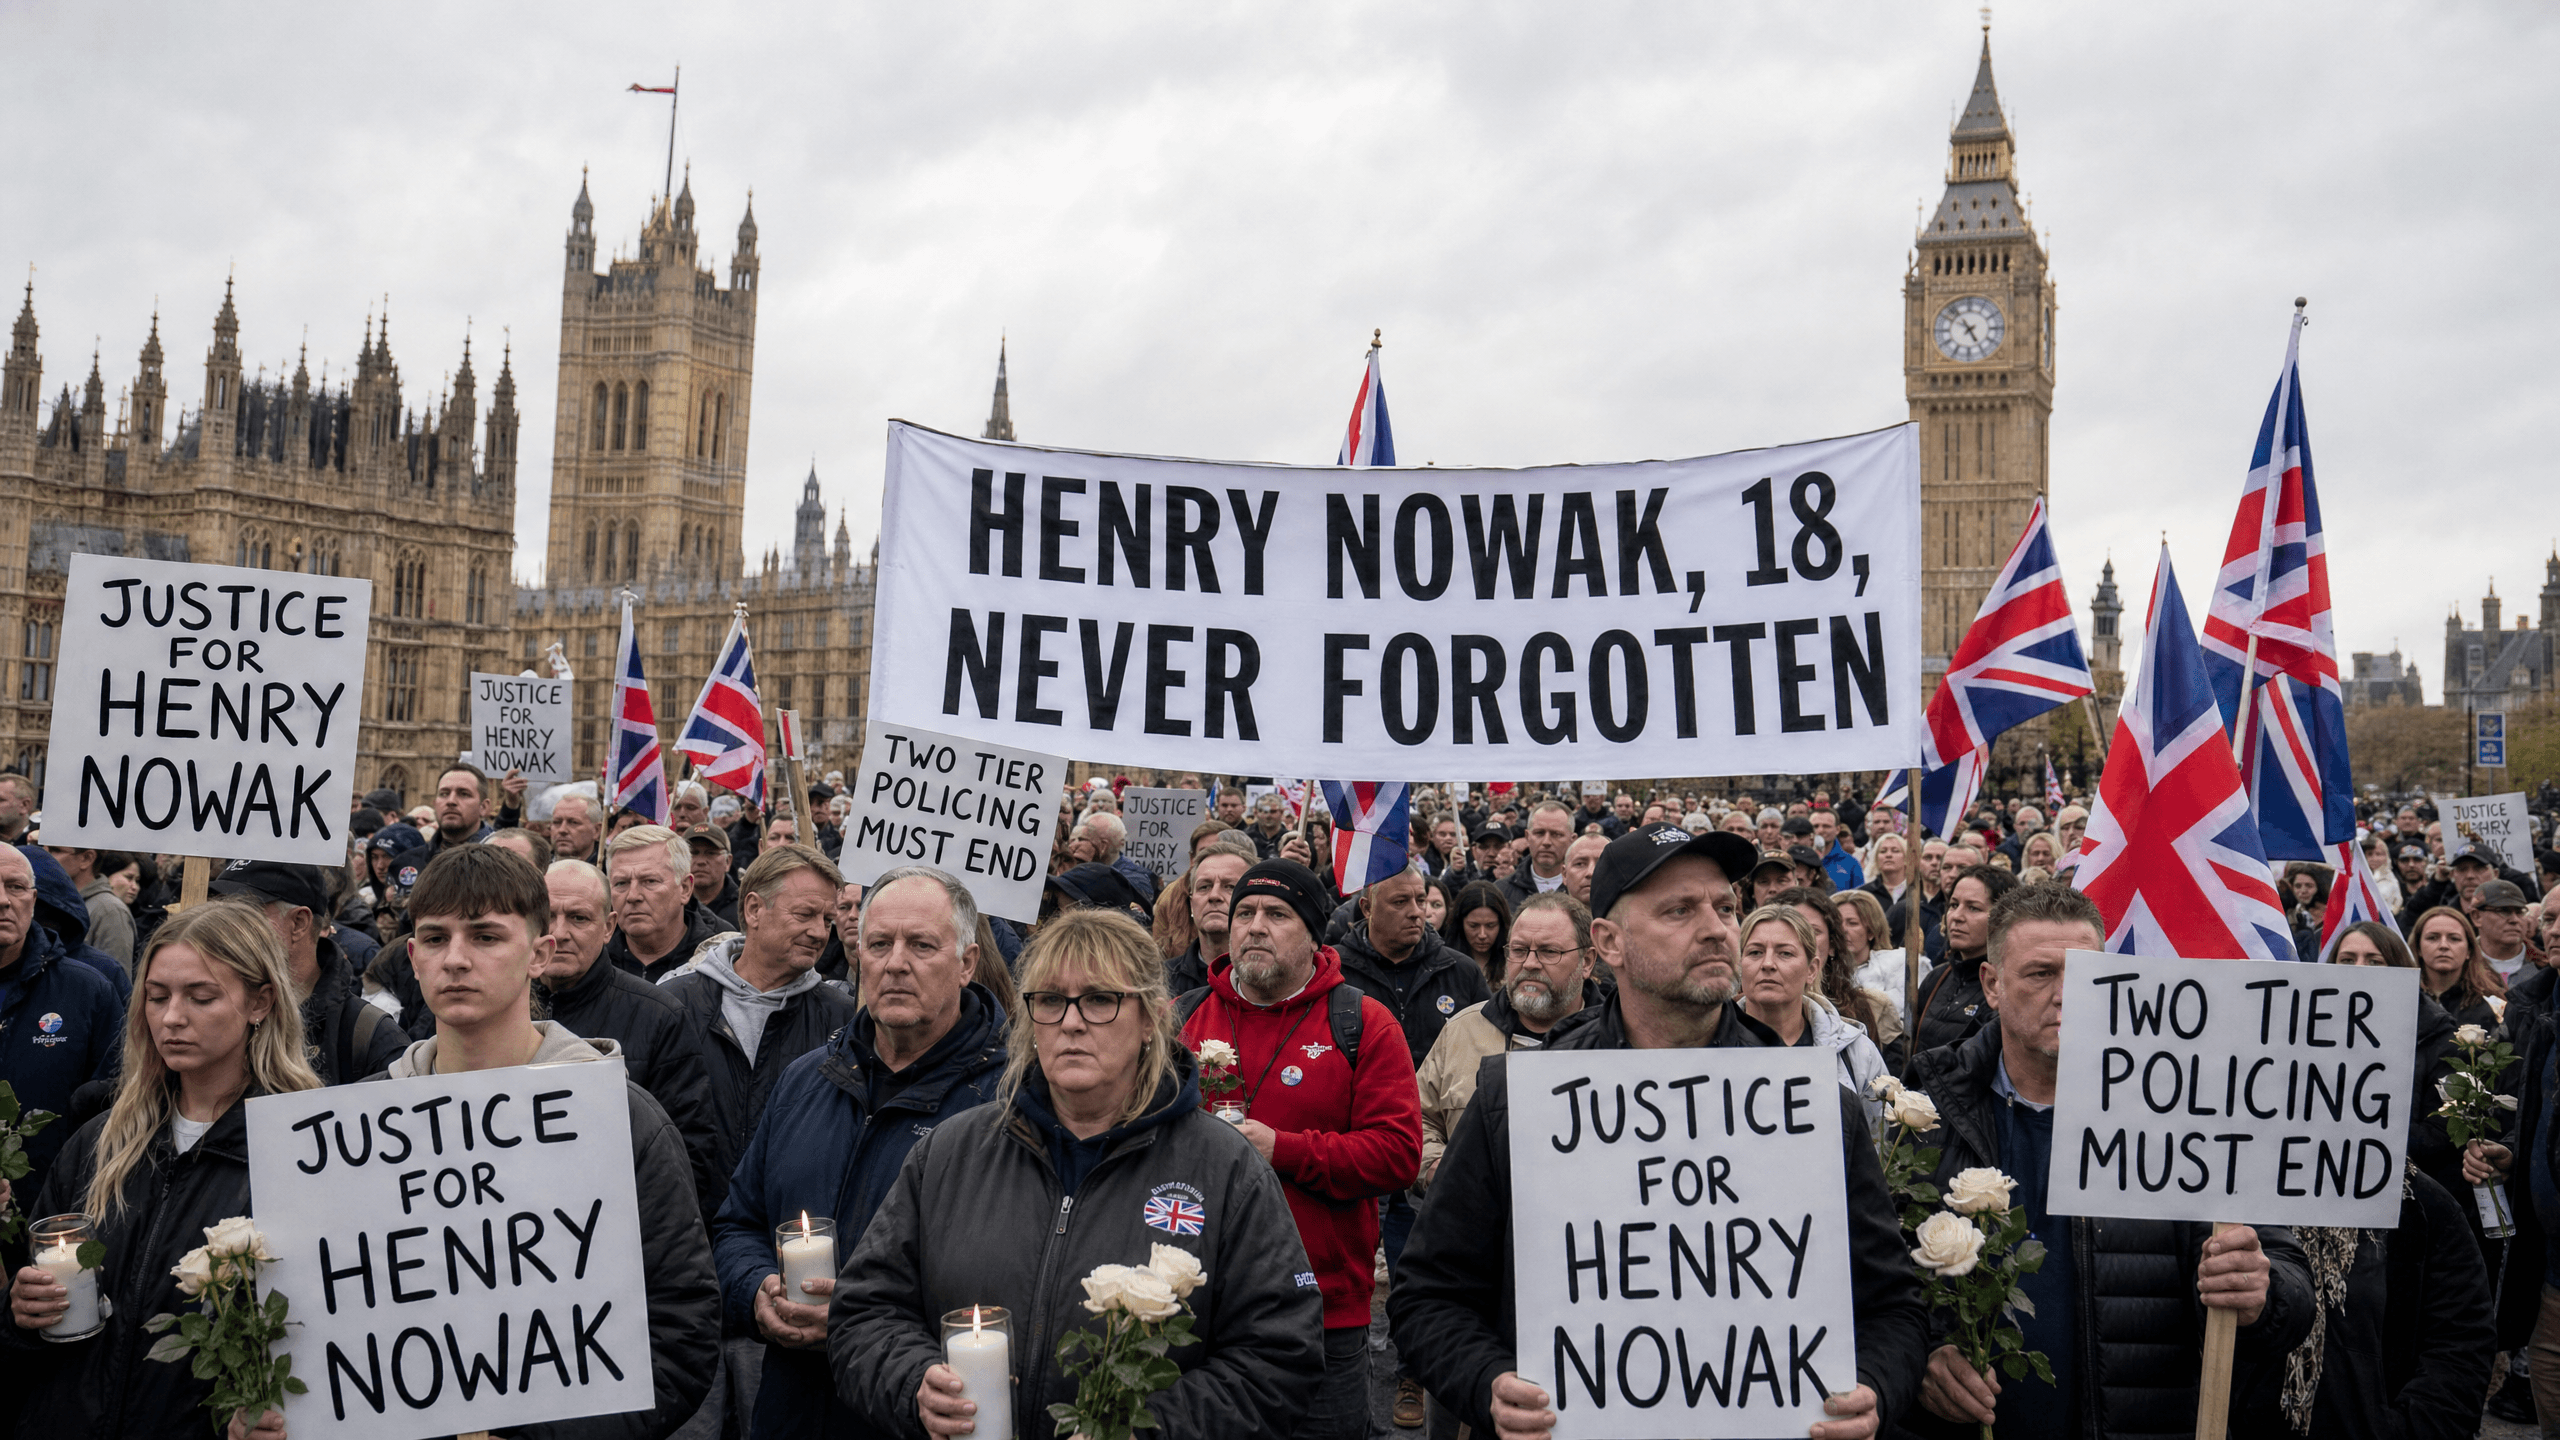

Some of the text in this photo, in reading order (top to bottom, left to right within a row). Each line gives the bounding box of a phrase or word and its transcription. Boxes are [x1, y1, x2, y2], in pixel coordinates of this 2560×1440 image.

[969, 468, 1869, 613] HENRY NOWAK, 18,
[101, 579, 347, 638] JUSTICE
[170, 637, 263, 673] FOR
[943, 608, 1888, 745] NEVER FORGOTTEN
[100, 668, 344, 748] HENRY
[481, 680, 561, 704] JUSTICE
[501, 706, 534, 725] FOR
[485, 750, 556, 773] NOWAK
[486, 726, 553, 750] HENRY
[885, 734, 1043, 794] TWO TIER
[78, 755, 331, 840] NOWAK
[872, 772, 1040, 836] POLICING
[1129, 796, 1196, 815] JUSTICE
[1139, 821, 1173, 838] FOR
[2453, 803, 2507, 820] JUSTICE
[857, 816, 1036, 881] MUST END
[1125, 841, 1178, 859] HENRY
[2093, 973, 2380, 1049] TWO TIER
[1552, 1075, 1814, 1153] JUSTICE
[2102, 1047, 2391, 1129] POLICING
[292, 1090, 578, 1174] JUSTICE
[2080, 1127, 2392, 1199] MUST END
[399, 1162, 504, 1214] FOR
[1638, 1156, 1739, 1206] FOR
[319, 1199, 602, 1315] HENRY
[1566, 1214, 1812, 1304] HENRY
[326, 1301, 624, 1421] NOWAK
[1554, 1323, 1831, 1411] NOWAK
